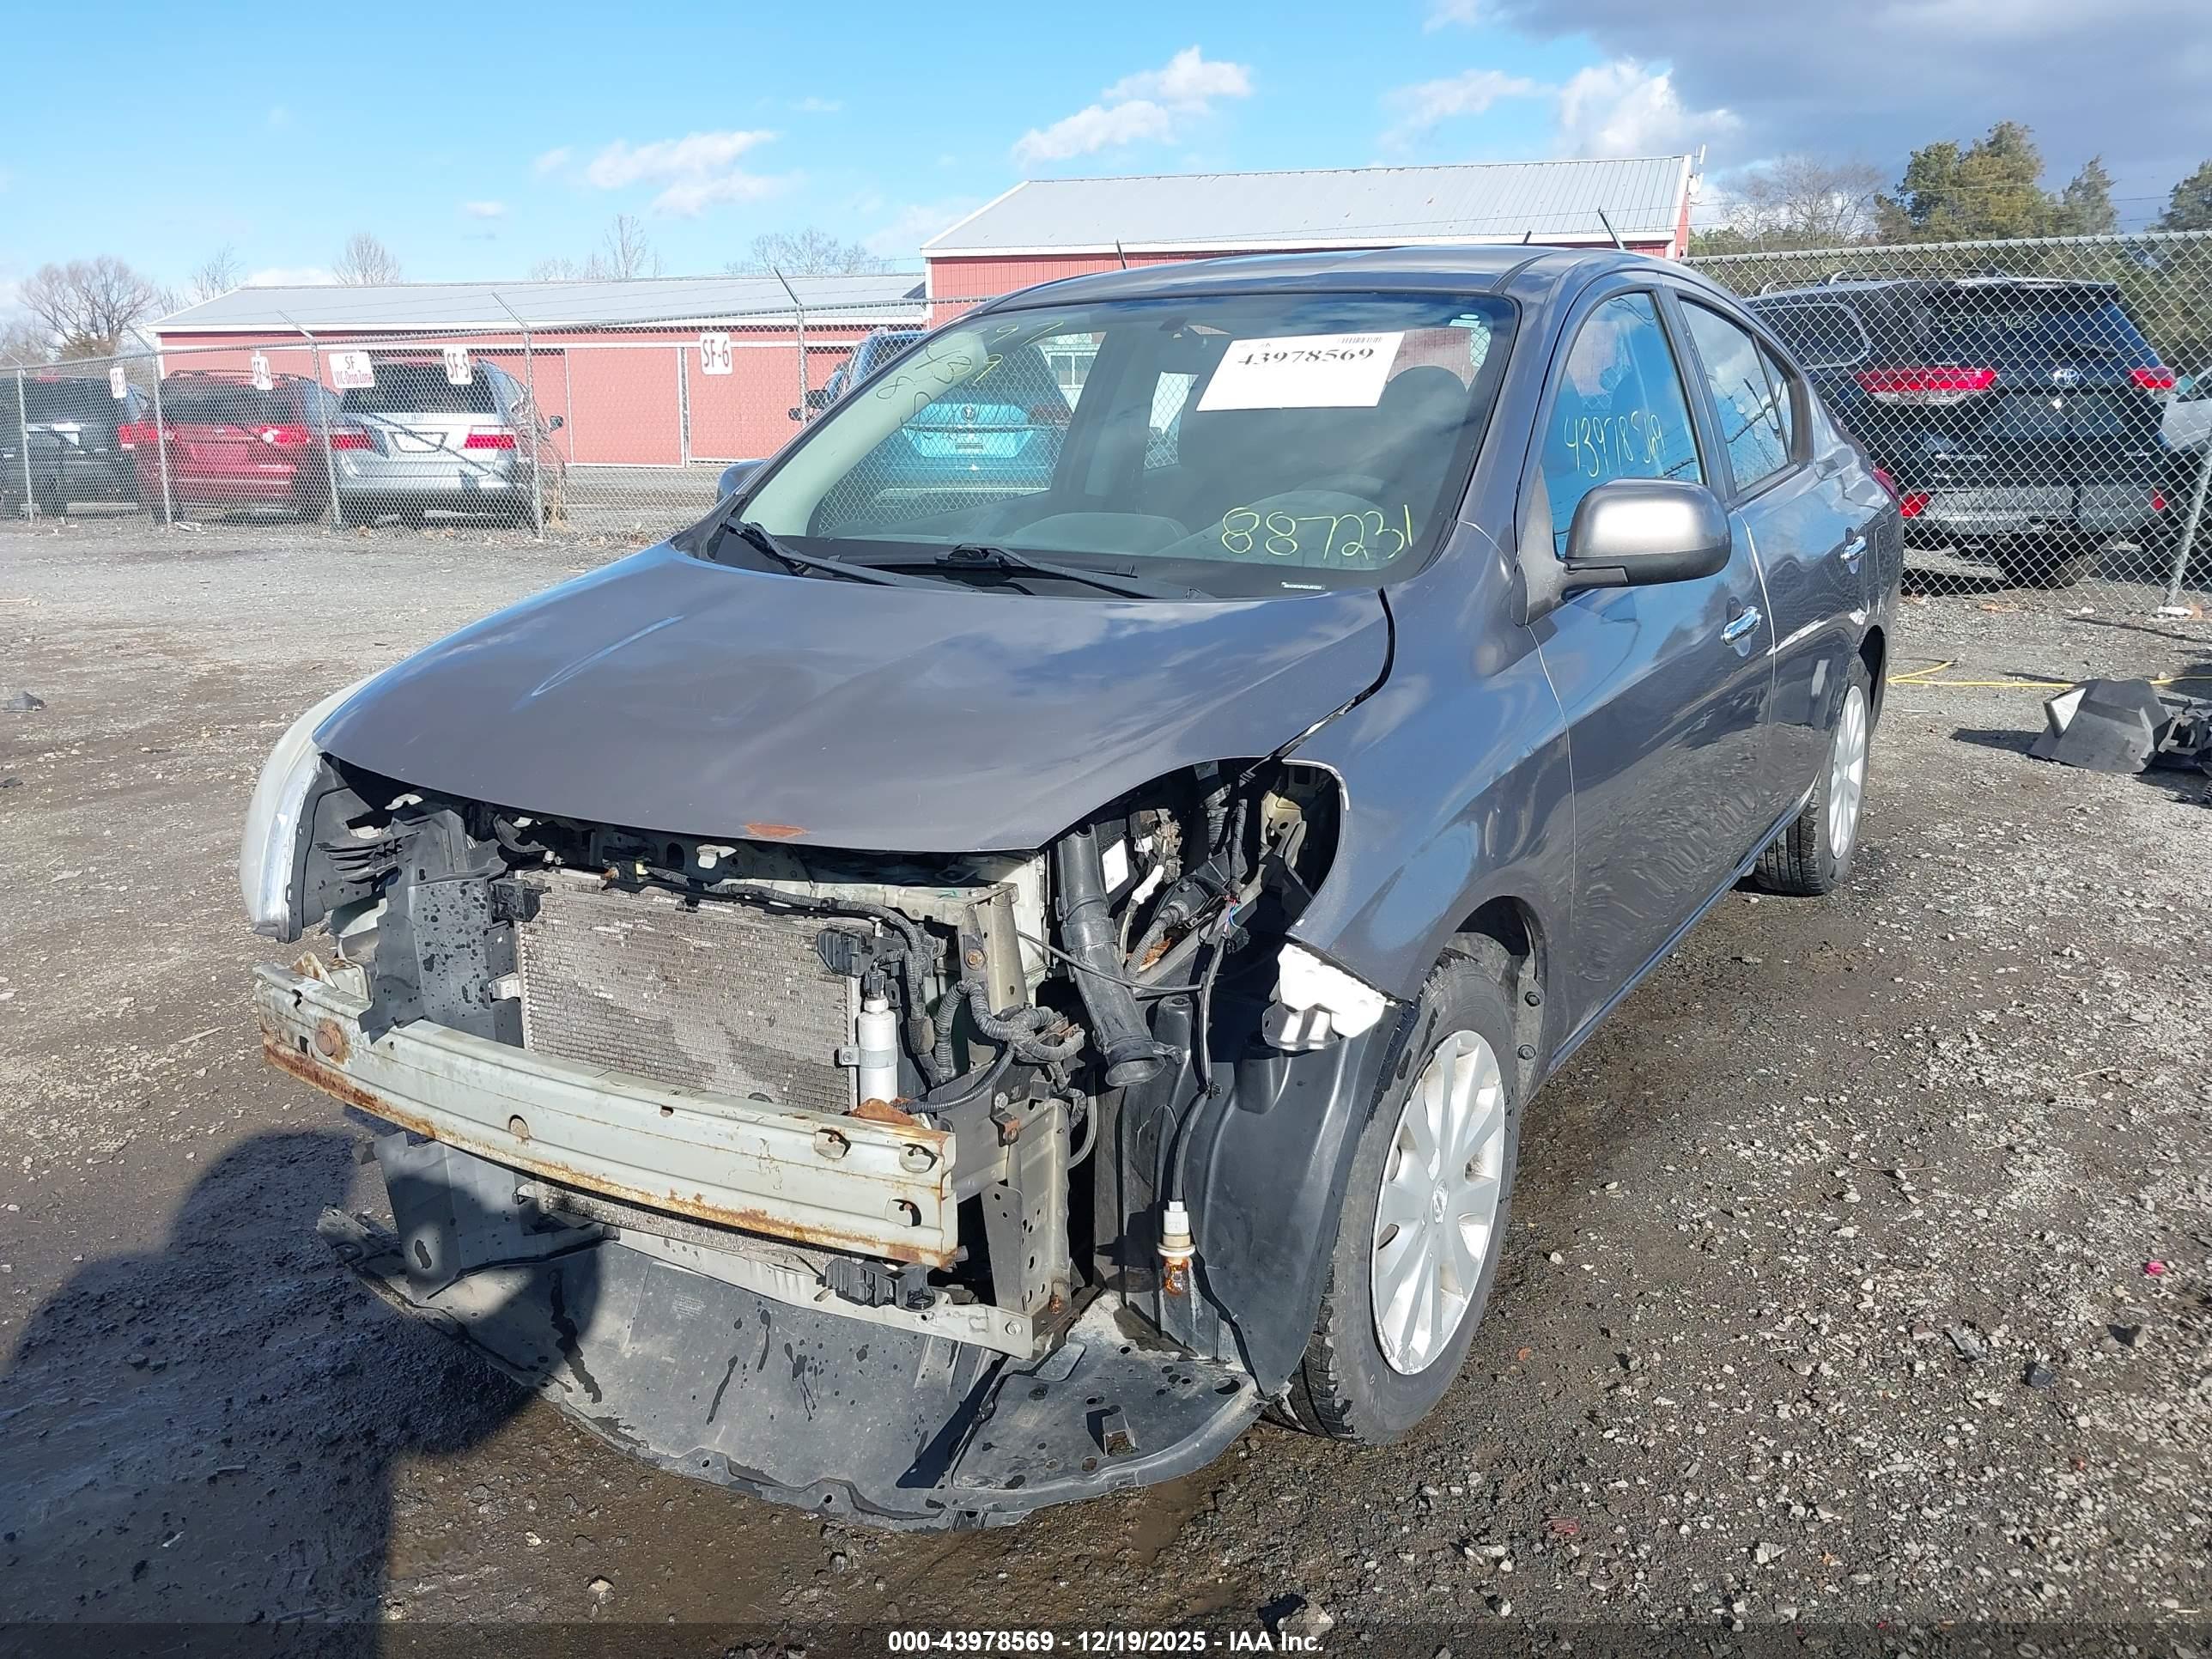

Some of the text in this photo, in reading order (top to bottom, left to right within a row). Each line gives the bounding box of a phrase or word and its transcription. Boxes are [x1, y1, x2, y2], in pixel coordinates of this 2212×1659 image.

[344, 356, 356, 370] SF
[447, 352, 470, 379] SF-5
[702, 338, 730, 368] SF-6
[1237, 348, 1375, 366] 43978569
[358, 369, 373, 384] Zone
[1565, 410, 1666, 477] 43978569
[1222, 505, 1413, 560] 887231
